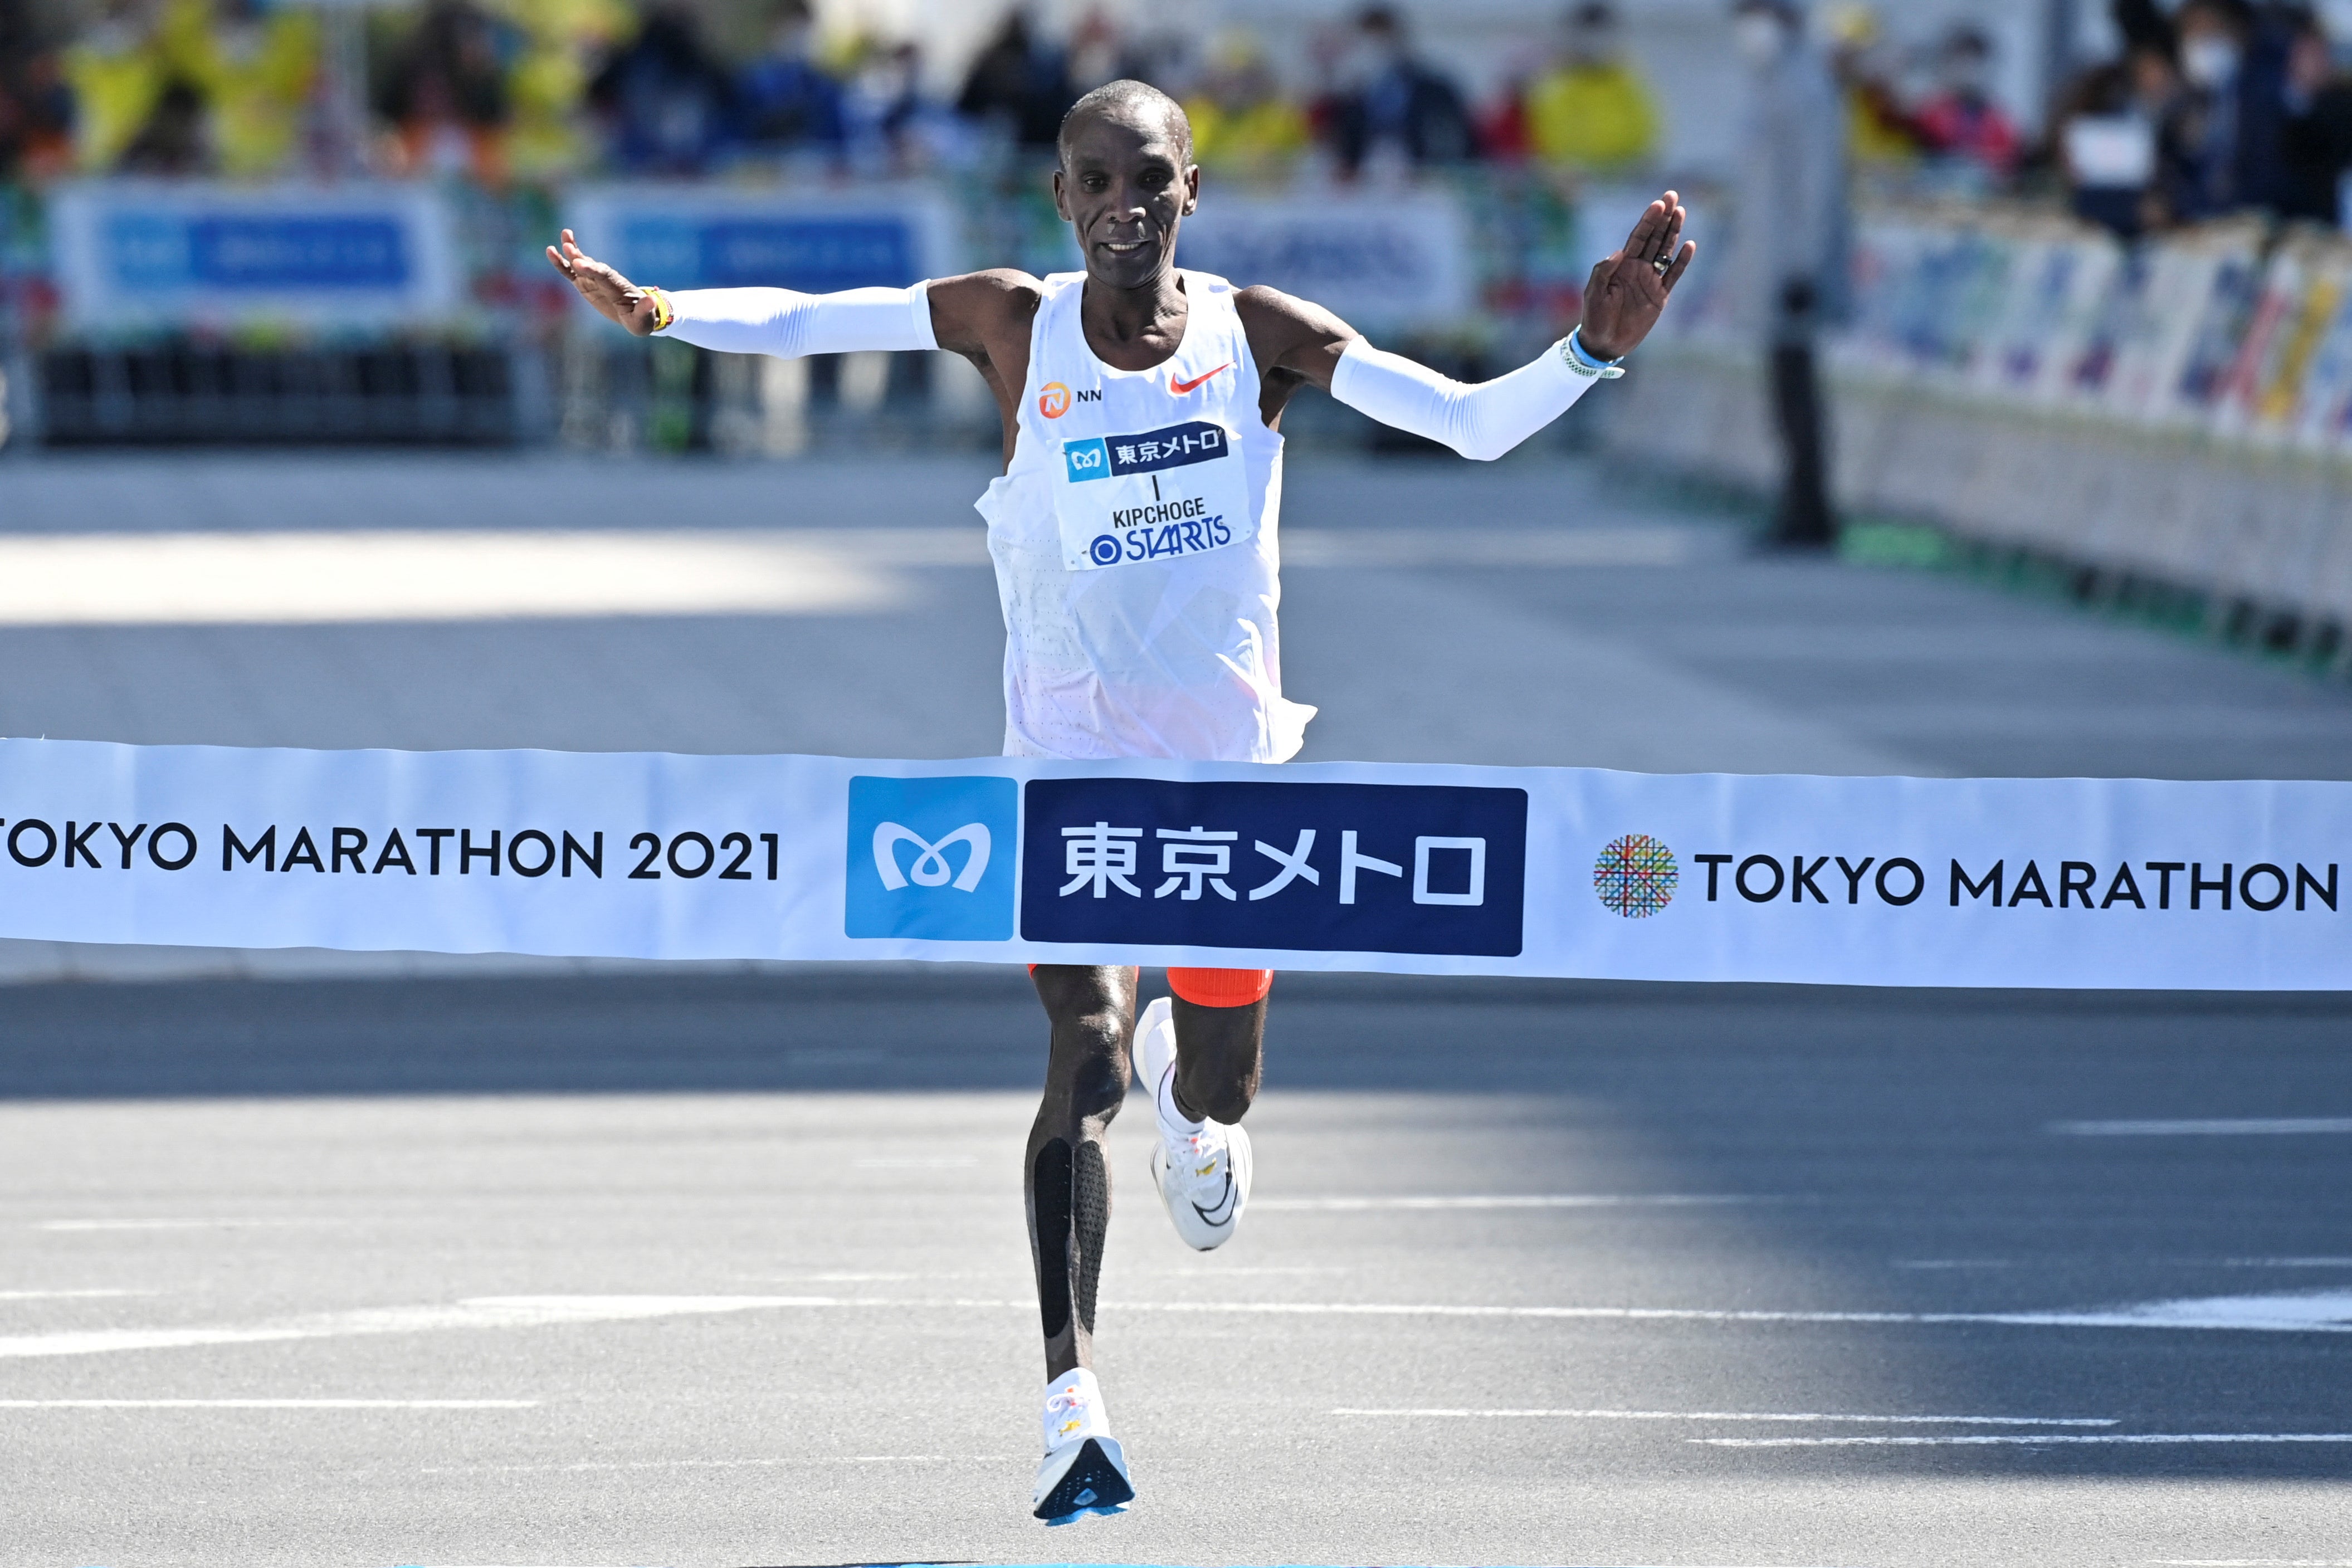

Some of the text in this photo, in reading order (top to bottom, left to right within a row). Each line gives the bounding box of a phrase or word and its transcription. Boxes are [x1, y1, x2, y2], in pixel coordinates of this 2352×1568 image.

[1077, 389, 1101, 402] NN
[1115, 429, 1219, 465] 東京メトロ
[1112, 497, 1206, 529] KIPCHOGE
[0, 818, 779, 881] OKYO MARATHON 2021
[1059, 821, 1486, 906] 東京メトロ
[1694, 853, 2339, 912] TOKYO MARATHON
